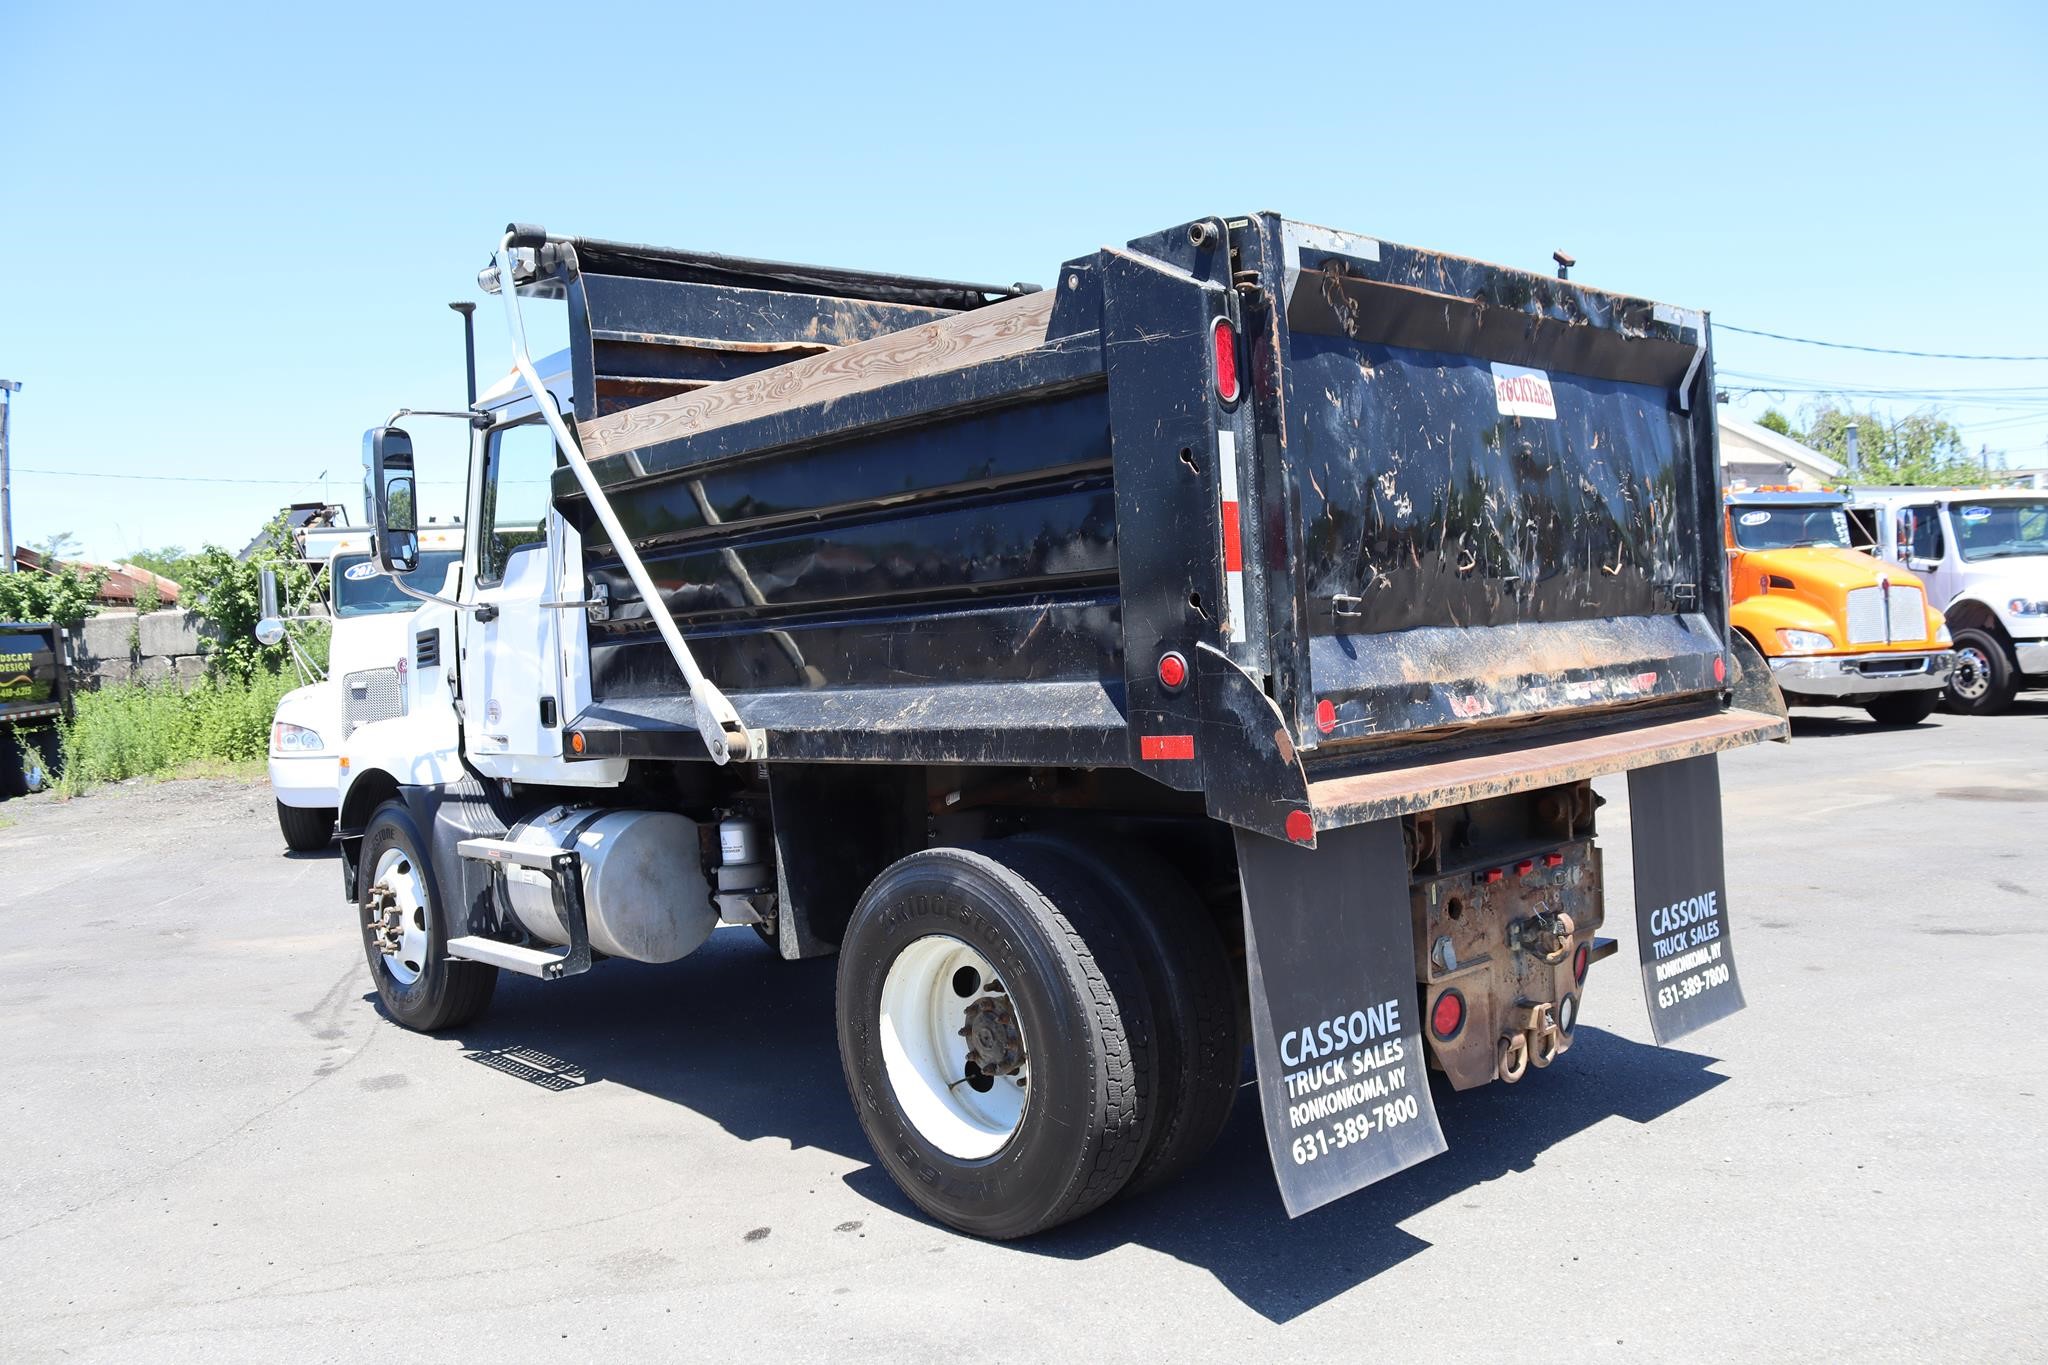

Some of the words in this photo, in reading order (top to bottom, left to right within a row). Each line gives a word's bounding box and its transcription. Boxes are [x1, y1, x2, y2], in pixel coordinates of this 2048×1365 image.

[1498, 377, 1552, 407] STOCKYARD
[1651, 890, 1718, 937] CASSONE
[1653, 931, 1688, 960] TRUCK
[1691, 920, 1720, 946] SALES
[1656, 947, 1712, 982] RONKONKOMA,
[1711, 941, 1722, 960] NY
[1658, 963, 1729, 1009] 631-389-7800
[1280, 999, 1401, 1067] CASSONE
[1284, 1057, 1347, 1099] TRUCK
[1352, 1038, 1404, 1076] SALES
[1289, 1078, 1389, 1129] RONKONKOMA,
[1388, 1066, 1406, 1092] NY
[1292, 1094, 1418, 1165] 631-389-7800
